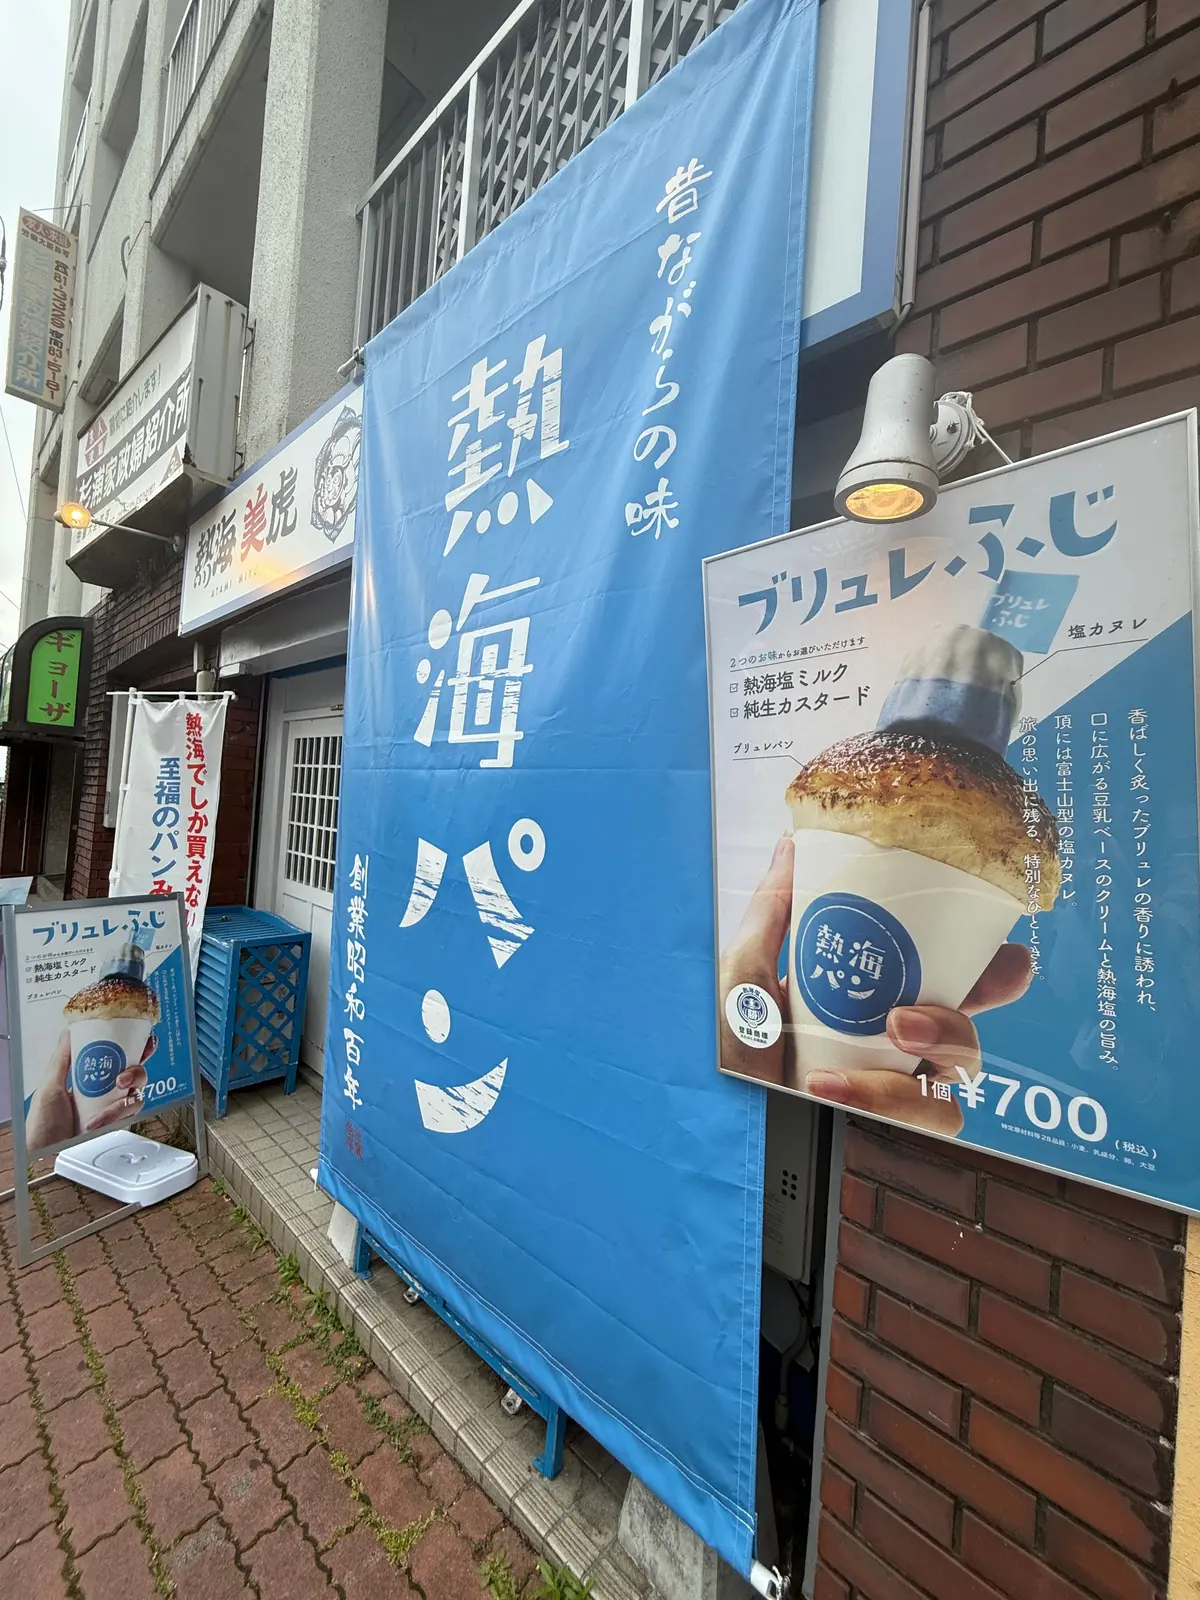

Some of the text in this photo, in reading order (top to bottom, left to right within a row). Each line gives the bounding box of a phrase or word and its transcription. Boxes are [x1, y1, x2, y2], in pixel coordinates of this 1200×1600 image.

[624, 157, 713, 540] 昔ながらの味
[193, 466, 298, 588] 熱海美虎
[738, 484, 1118, 635] ブリュレふじ
[1067, 616, 1149, 640] 塩カヌレ
[39, 631, 76, 723] ギョーザ
[743, 662, 850, 696] 熱海塩ミルク
[743, 685, 871, 720] 純生カスタード
[399, 334, 570, 1134] 熱海パン
[733, 738, 794, 757] ブリュレパン
[184, 712, 209, 928] 熱海でしか買えない
[1053, 714, 1078, 908] 頂には富士山型の塩カヌレ。
[1127, 707, 1156, 1012] 香ばしく炙ったブリュレの香りに誘われ、
[33, 909, 165, 946] ブリュレふじ
[815, 923, 886, 981] 熱海
[34, 957, 88, 974] 熱海塩ミルク
[34, 965, 97, 983] 純生カスタード
[343, 853, 369, 1110] 創業昭和百年
[810, 964, 876, 1001] パン
[136, 1076, 177, 1102] ¥700
[916, 1073, 951, 1102] 1個
[955, 1066, 1108, 1143] ¥700
